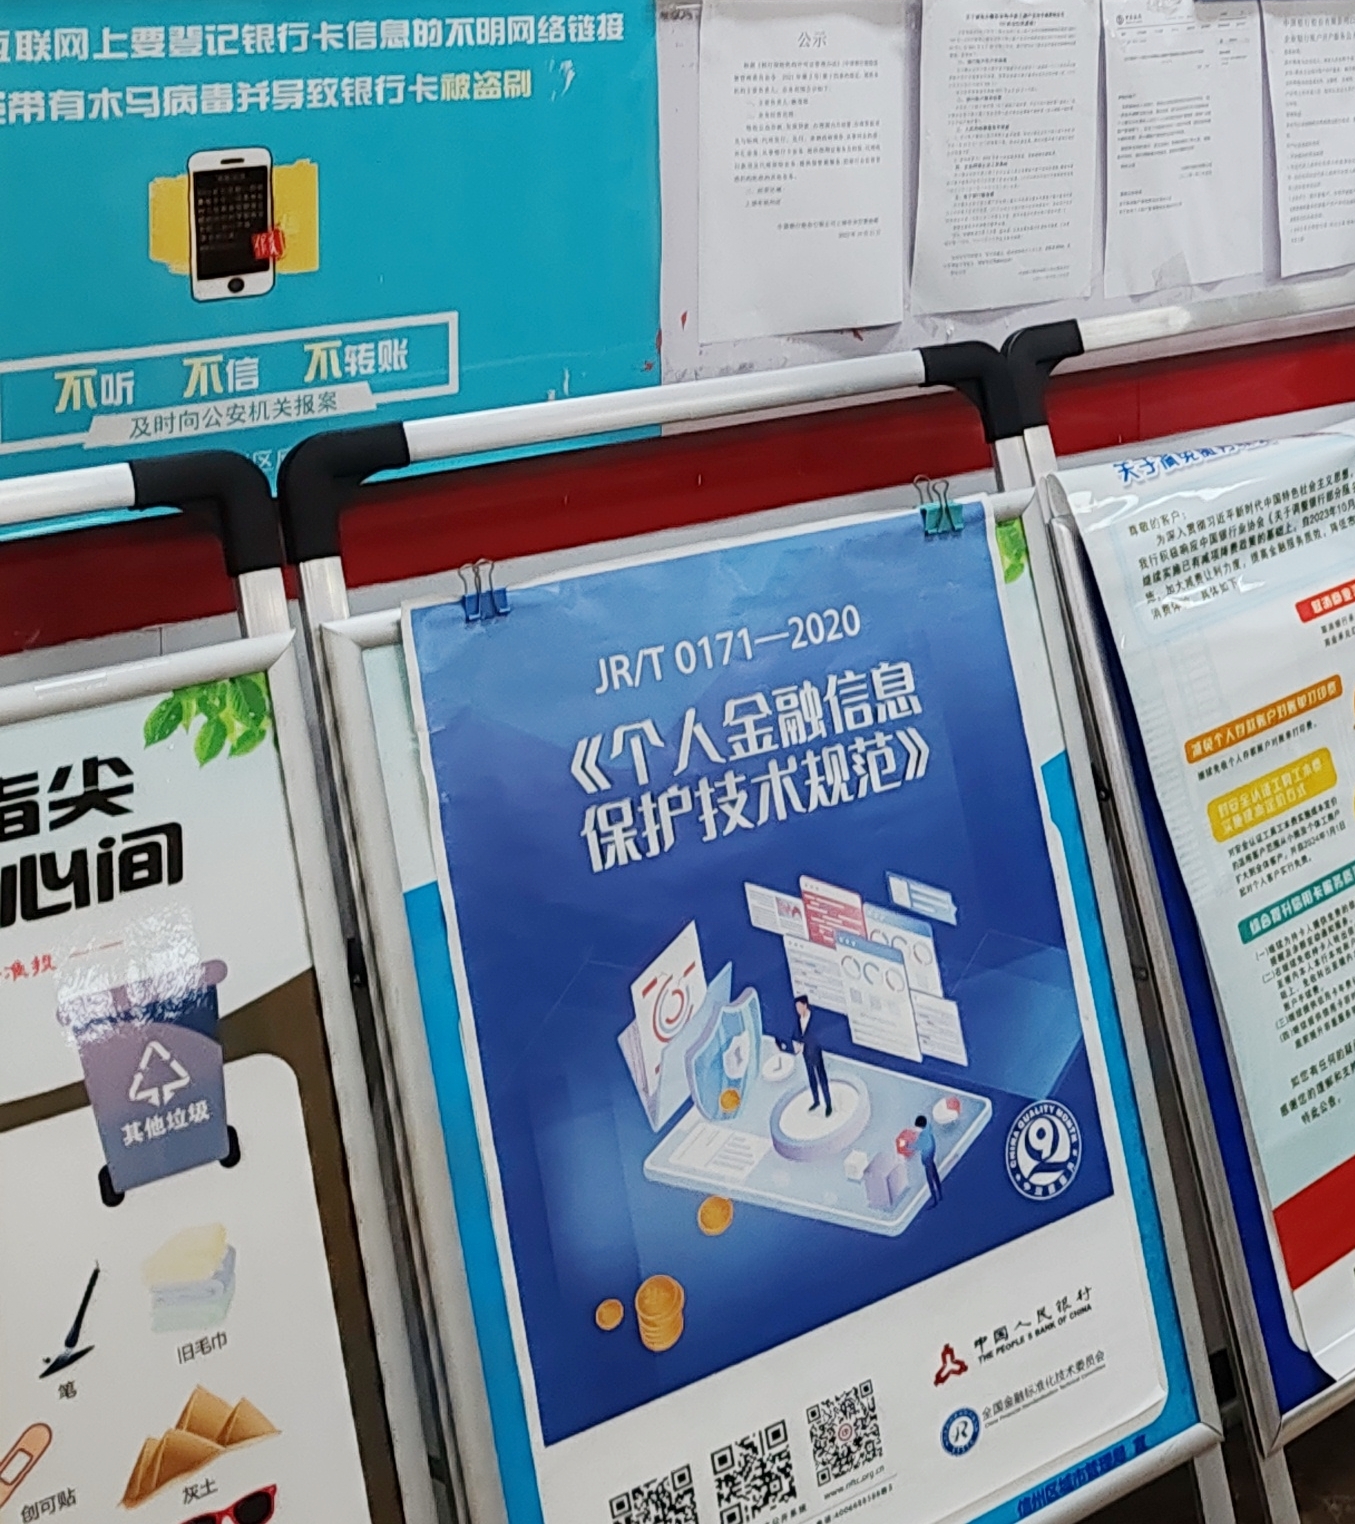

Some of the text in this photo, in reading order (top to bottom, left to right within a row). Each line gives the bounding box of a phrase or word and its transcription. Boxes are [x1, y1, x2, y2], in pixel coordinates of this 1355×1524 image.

[55, 338, 409, 414] 不听 不信 不转账
[129, 390, 338, 439] 及时向公安机关报案
[595, 644, 664, 695] JR/T
[571, 660, 922, 795] 《个人金融信息
[580, 725, 929, 874] 保护技术规范》
[120, 1100, 210, 1148] 其他垃圾
[974, 1286, 1092, 1352] 中国人民银行
[978, 1304, 1092, 1365] THE BANK OF CHINA
[177, 1332, 228, 1364] 旧毛巾
[57, 1381, 77, 1400] 笔
[982, 1350, 1104, 1420] 全国金融标准化技术委员会
[21, 1488, 76, 1524] 创可贴
[182, 1479, 218, 1505] 灰土
